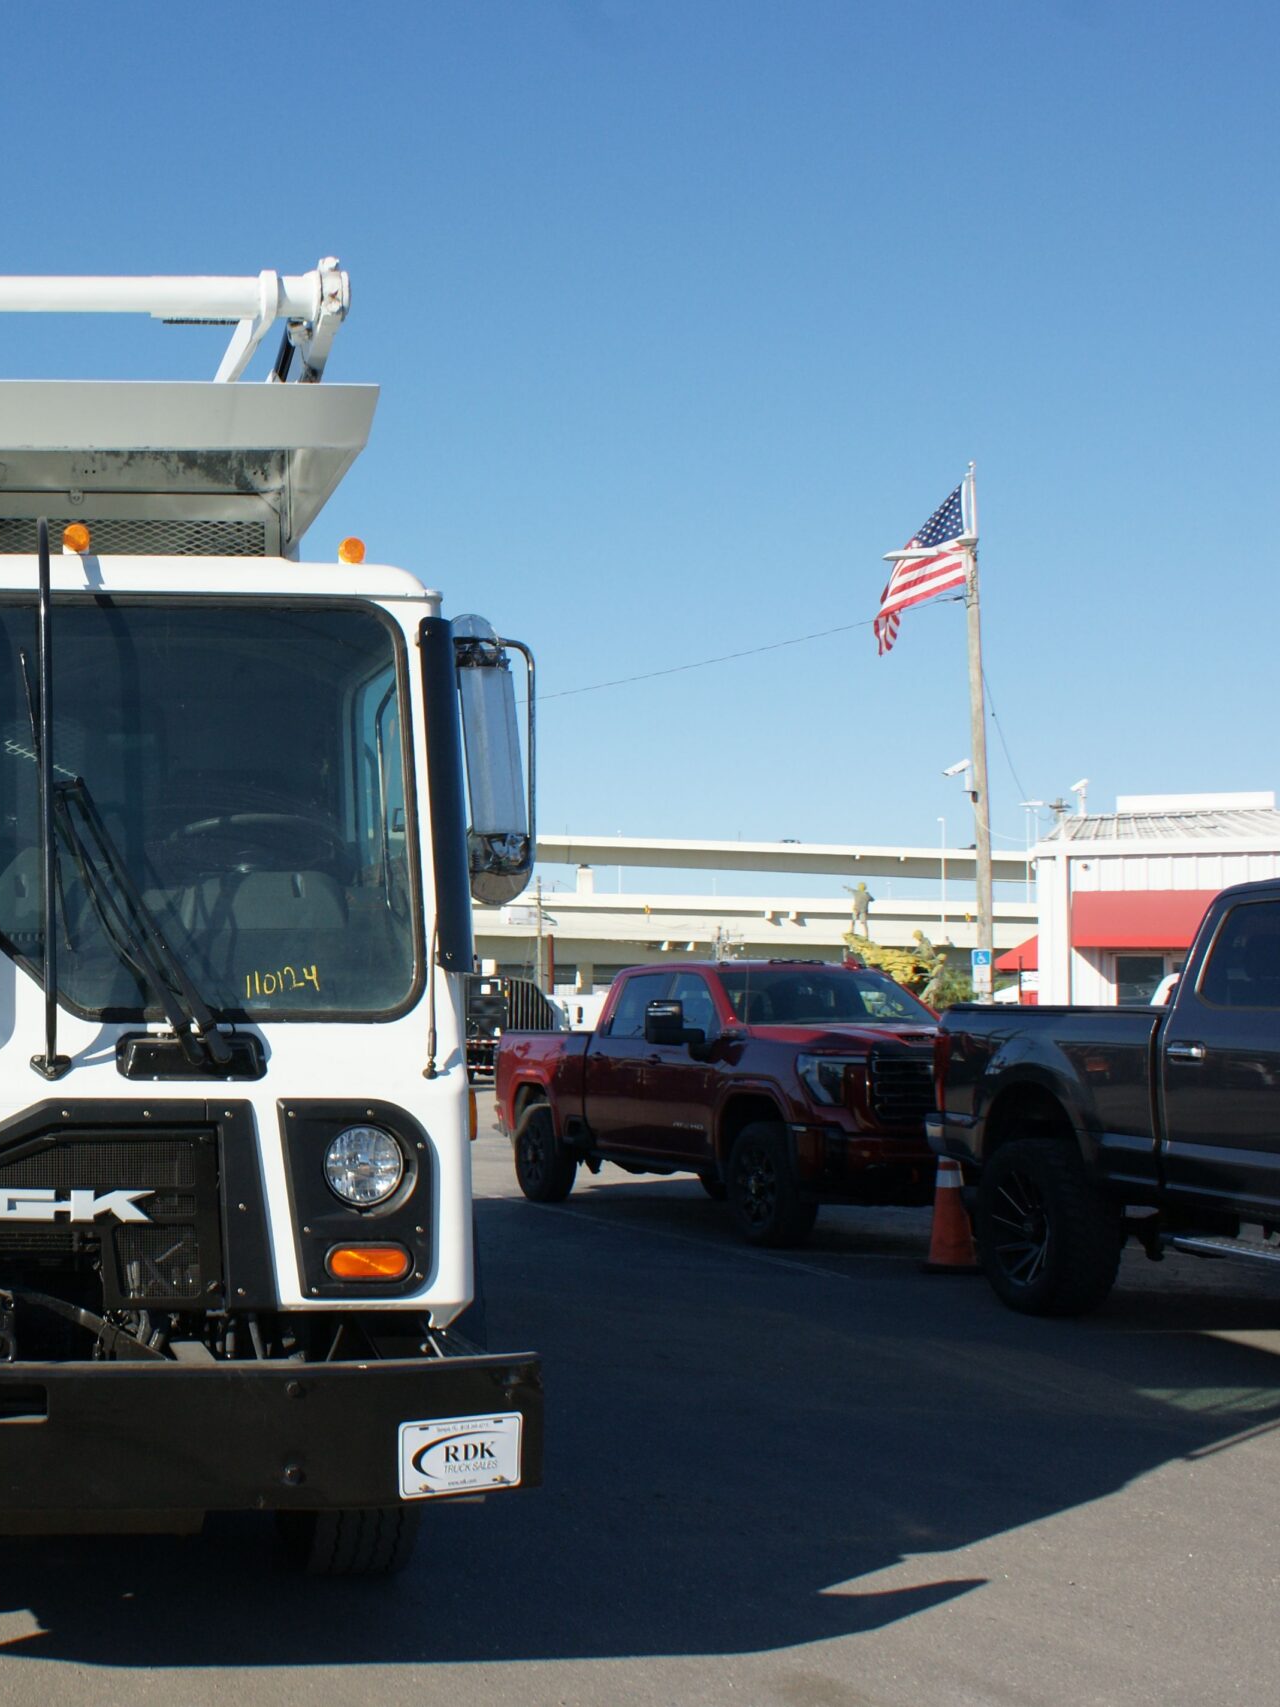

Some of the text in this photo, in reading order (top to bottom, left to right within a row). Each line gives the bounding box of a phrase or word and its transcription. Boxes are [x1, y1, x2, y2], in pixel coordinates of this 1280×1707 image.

[246, 965, 320, 998] 110124
[444, 1441, 495, 1463] RDK
[444, 1460, 497, 1474] TRUCK SALES
